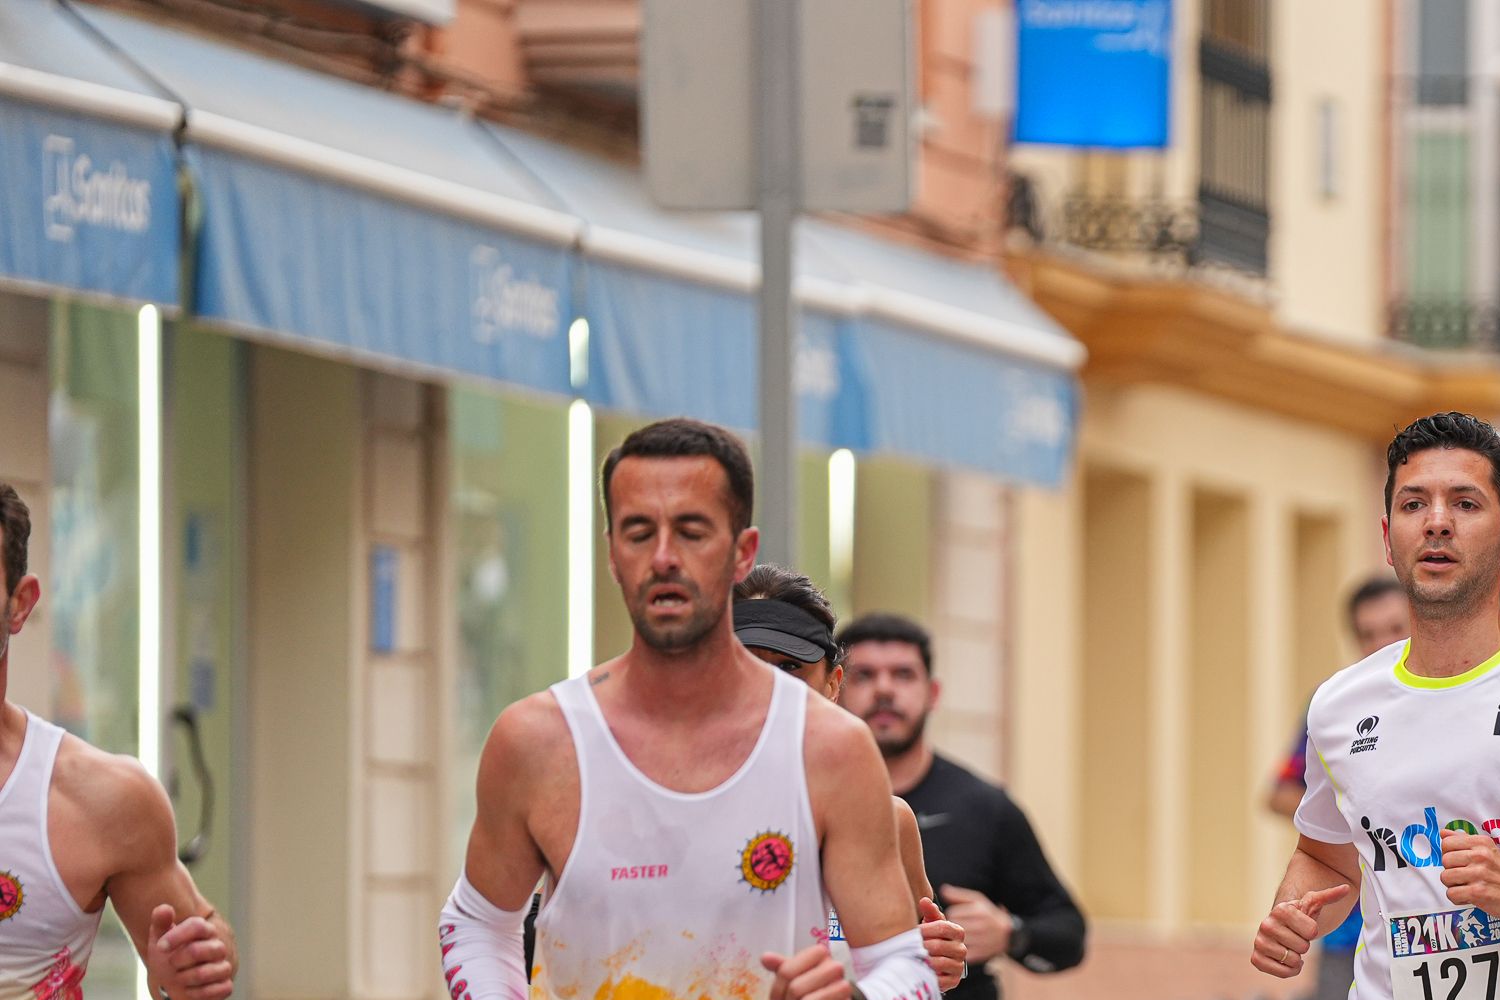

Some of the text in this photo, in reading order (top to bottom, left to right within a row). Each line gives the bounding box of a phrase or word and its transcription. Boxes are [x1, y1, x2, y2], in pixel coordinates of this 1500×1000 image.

[1351, 736, 1379, 748] SPORTING
[611, 864, 669, 881] FASTER
[1407, 914, 1458, 953] 21K
